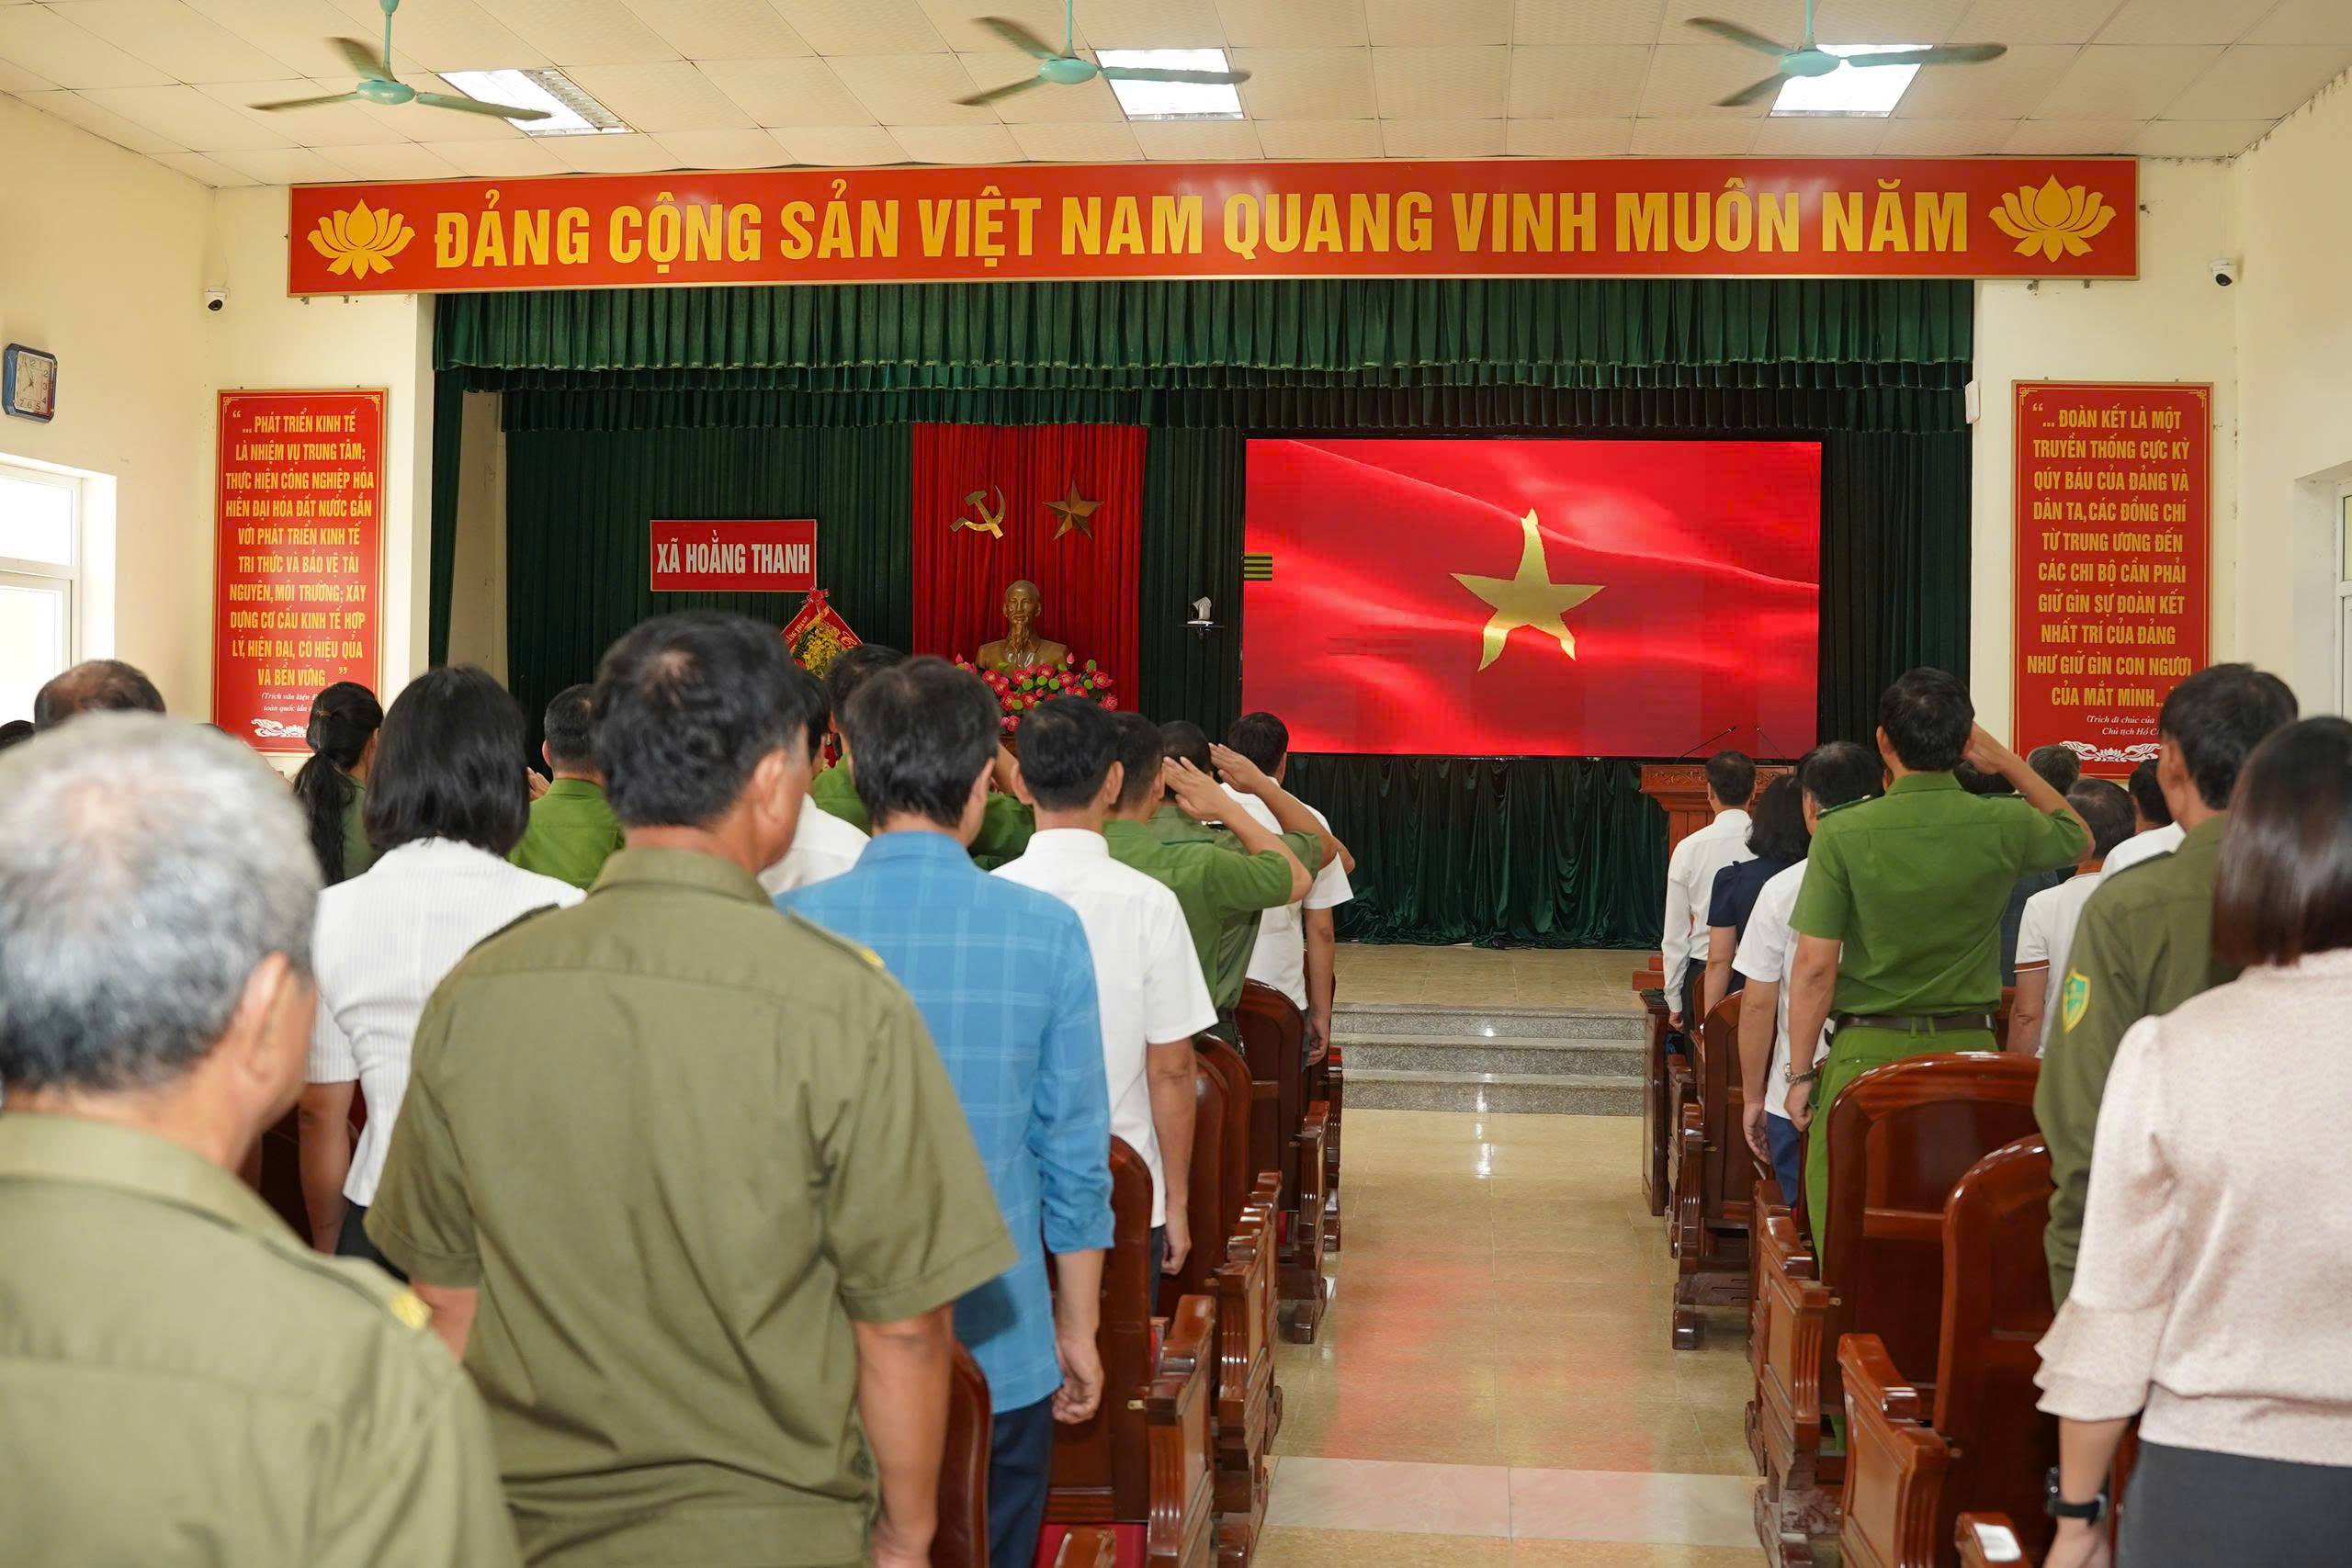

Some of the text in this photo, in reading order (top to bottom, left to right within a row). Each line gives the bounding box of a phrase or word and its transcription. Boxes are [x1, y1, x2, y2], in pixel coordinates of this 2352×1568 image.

[435, 176, 1968, 274] ĐẢNG CỘNG SẢN VIỆT NAM QUANG VINH MUÔN NĂM
[254, 412, 280, 433] PHÁT
[284, 407, 313, 433] TRIỂN
[316, 415, 340, 432] KINH
[344, 408, 357, 432] TẾ
[2059, 405, 2097, 428] ĐOÀN
[2101, 403, 2126, 428] KẾT
[2131, 406, 2147, 429] LÀ
[2152, 406, 2181, 434] MỘT
[235, 439, 247, 460] LÀ
[250, 439, 284, 465] NHIỆM
[288, 444, 300, 465] VỤ
[303, 443, 336, 460] TRUNG
[2090, 434, 2136, 459] THỐNG
[2140, 439, 2168, 463] CỰC
[2172, 437, 2189, 459] KỲ
[226, 467, 374, 493] THỰC HIỆN CÔNG NGHIỆP HÓA
[2064, 467, 2093, 491] BÁU
[2097, 464, 2125, 491] CỦA
[2129, 465, 2166, 491] ĐẢNG
[2171, 468, 2189, 491] VÀ
[253, 500, 269, 521] ĐẠI
[272, 495, 293, 517] HÓA
[296, 493, 316, 516] ĐẤT
[319, 493, 346, 516] NƯỚC
[350, 491, 372, 516] GẮN
[2033, 497, 2062, 520] DÂN
[2088, 497, 2117, 521] CÁC
[2120, 496, 2159, 522] ĐỒNG
[2163, 499, 2187, 522] CHÍ
[238, 519, 361, 545] VỚI PHÁT TRIỂN KINH TẾ
[2041, 527, 2183, 552] TỪ TRUNG ƯƠNG ĐẾN
[238, 548, 359, 578] TRI THỨC VÀ BẢO VỆ TÀI
[657, 529, 810, 574] XÃ HOẰNG THANH
[2038, 557, 2186, 587] CÁC CHI BỘ CẦN PHẢI
[275, 579, 295, 602] MÔI
[345, 581, 368, 603] XÂY
[2038, 589, 2185, 617] GIỮ GÌN SỰ ĐOÀN KẾT
[230, 605, 366, 633] DỰNG CƠ CẤU KINH TẾ HỢP
[2041, 617, 2176, 645] NHẤT TRÍ CỦA ĐẢNG
[248, 636, 272, 661] HIỆN
[299, 636, 312, 658] CÓ
[314, 636, 338, 661] HIỆU
[342, 633, 363, 660] QUẢ
[258, 664, 271, 686] VÀ
[298, 664, 326, 686] VỮNG
[2027, 654, 2057, 674] NHƯ
[2061, 650, 2085, 674] GIỮ
[2087, 651, 2112, 675] GÌN
[2116, 657, 2145, 675] CON
[2052, 680, 2079, 705] CỦA
[2084, 681, 2113, 706] MẮT
